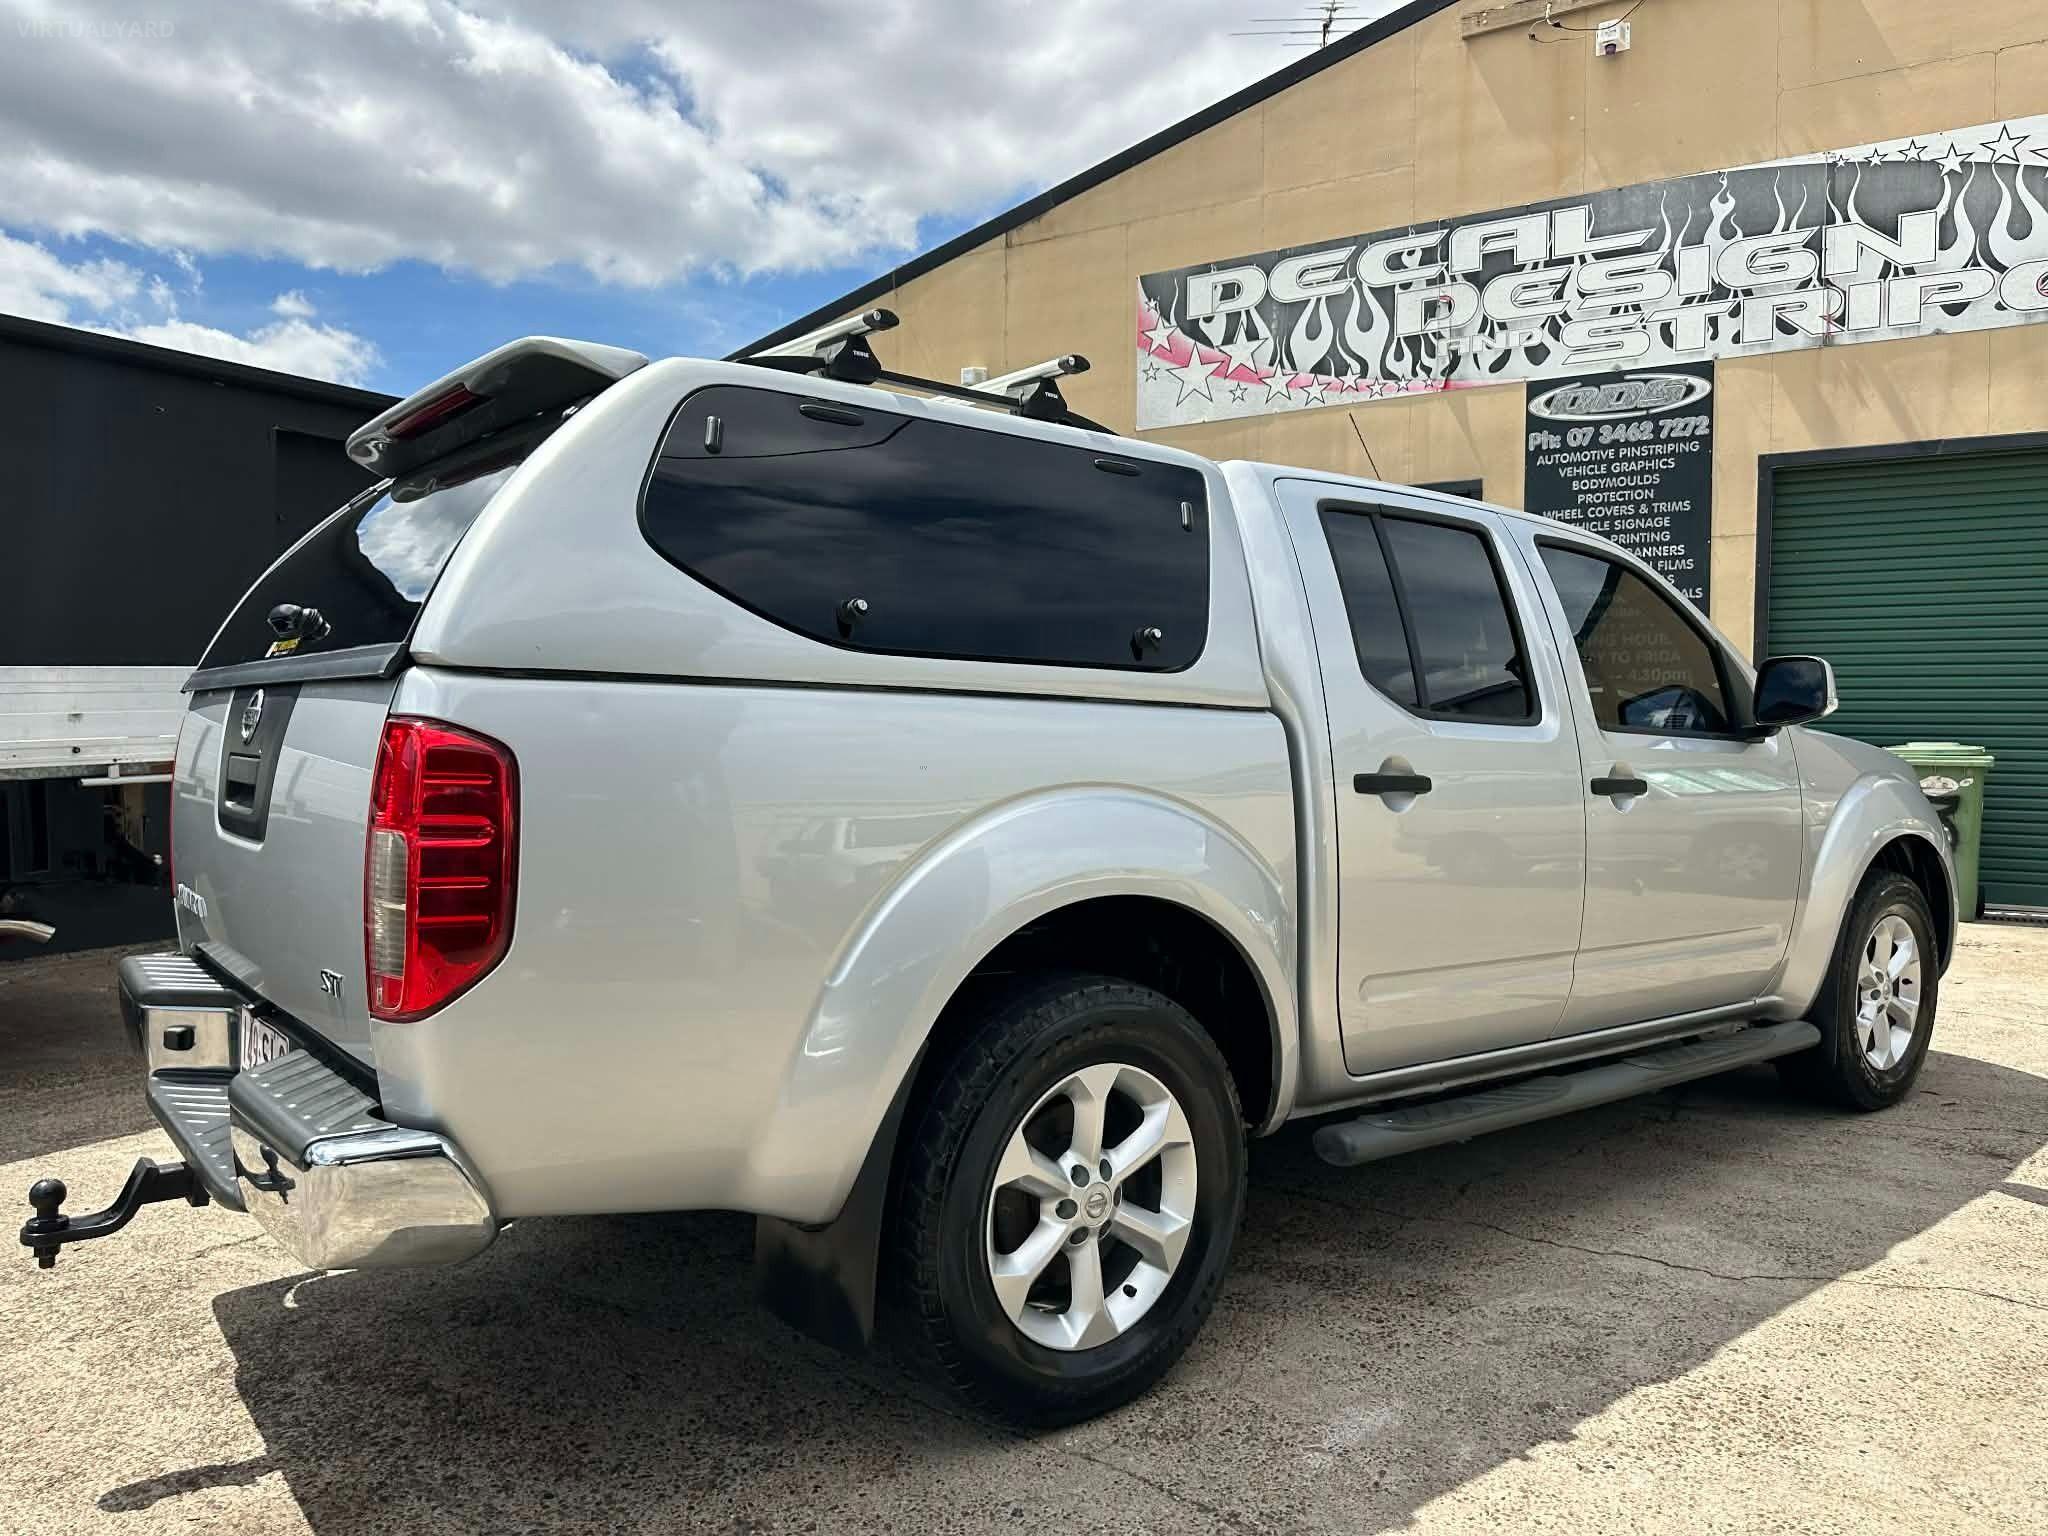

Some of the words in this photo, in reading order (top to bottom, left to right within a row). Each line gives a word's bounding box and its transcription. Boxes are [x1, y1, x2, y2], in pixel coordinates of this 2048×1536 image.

[1187, 204, 1656, 320] DECAL
[1394, 208, 1940, 338] DESIGN
[1566, 426, 1595, 448] 07
[1598, 420, 1654, 445] 3462
[1658, 415, 1711, 440] 7272
[1536, 450, 1616, 467] AUTOMOTIVE
[1619, 440, 1701, 459] PINSTRIPING
[1558, 463, 1608, 478] VEHICLE
[1611, 458, 1676, 474] GRAPHICS
[1571, 473, 1661, 491] BODYMOULDS
[1577, 488, 1655, 505] PROTECTION
[1587, 503, 1635, 518] COVERS
[1638, 503, 1649, 515] &
[1652, 500, 1692, 514] TRIMS
[1614, 516, 1671, 530] SIGNAGE
[1610, 530, 1671, 544] PRINTING
[1657, 558, 1695, 571] FILMS
